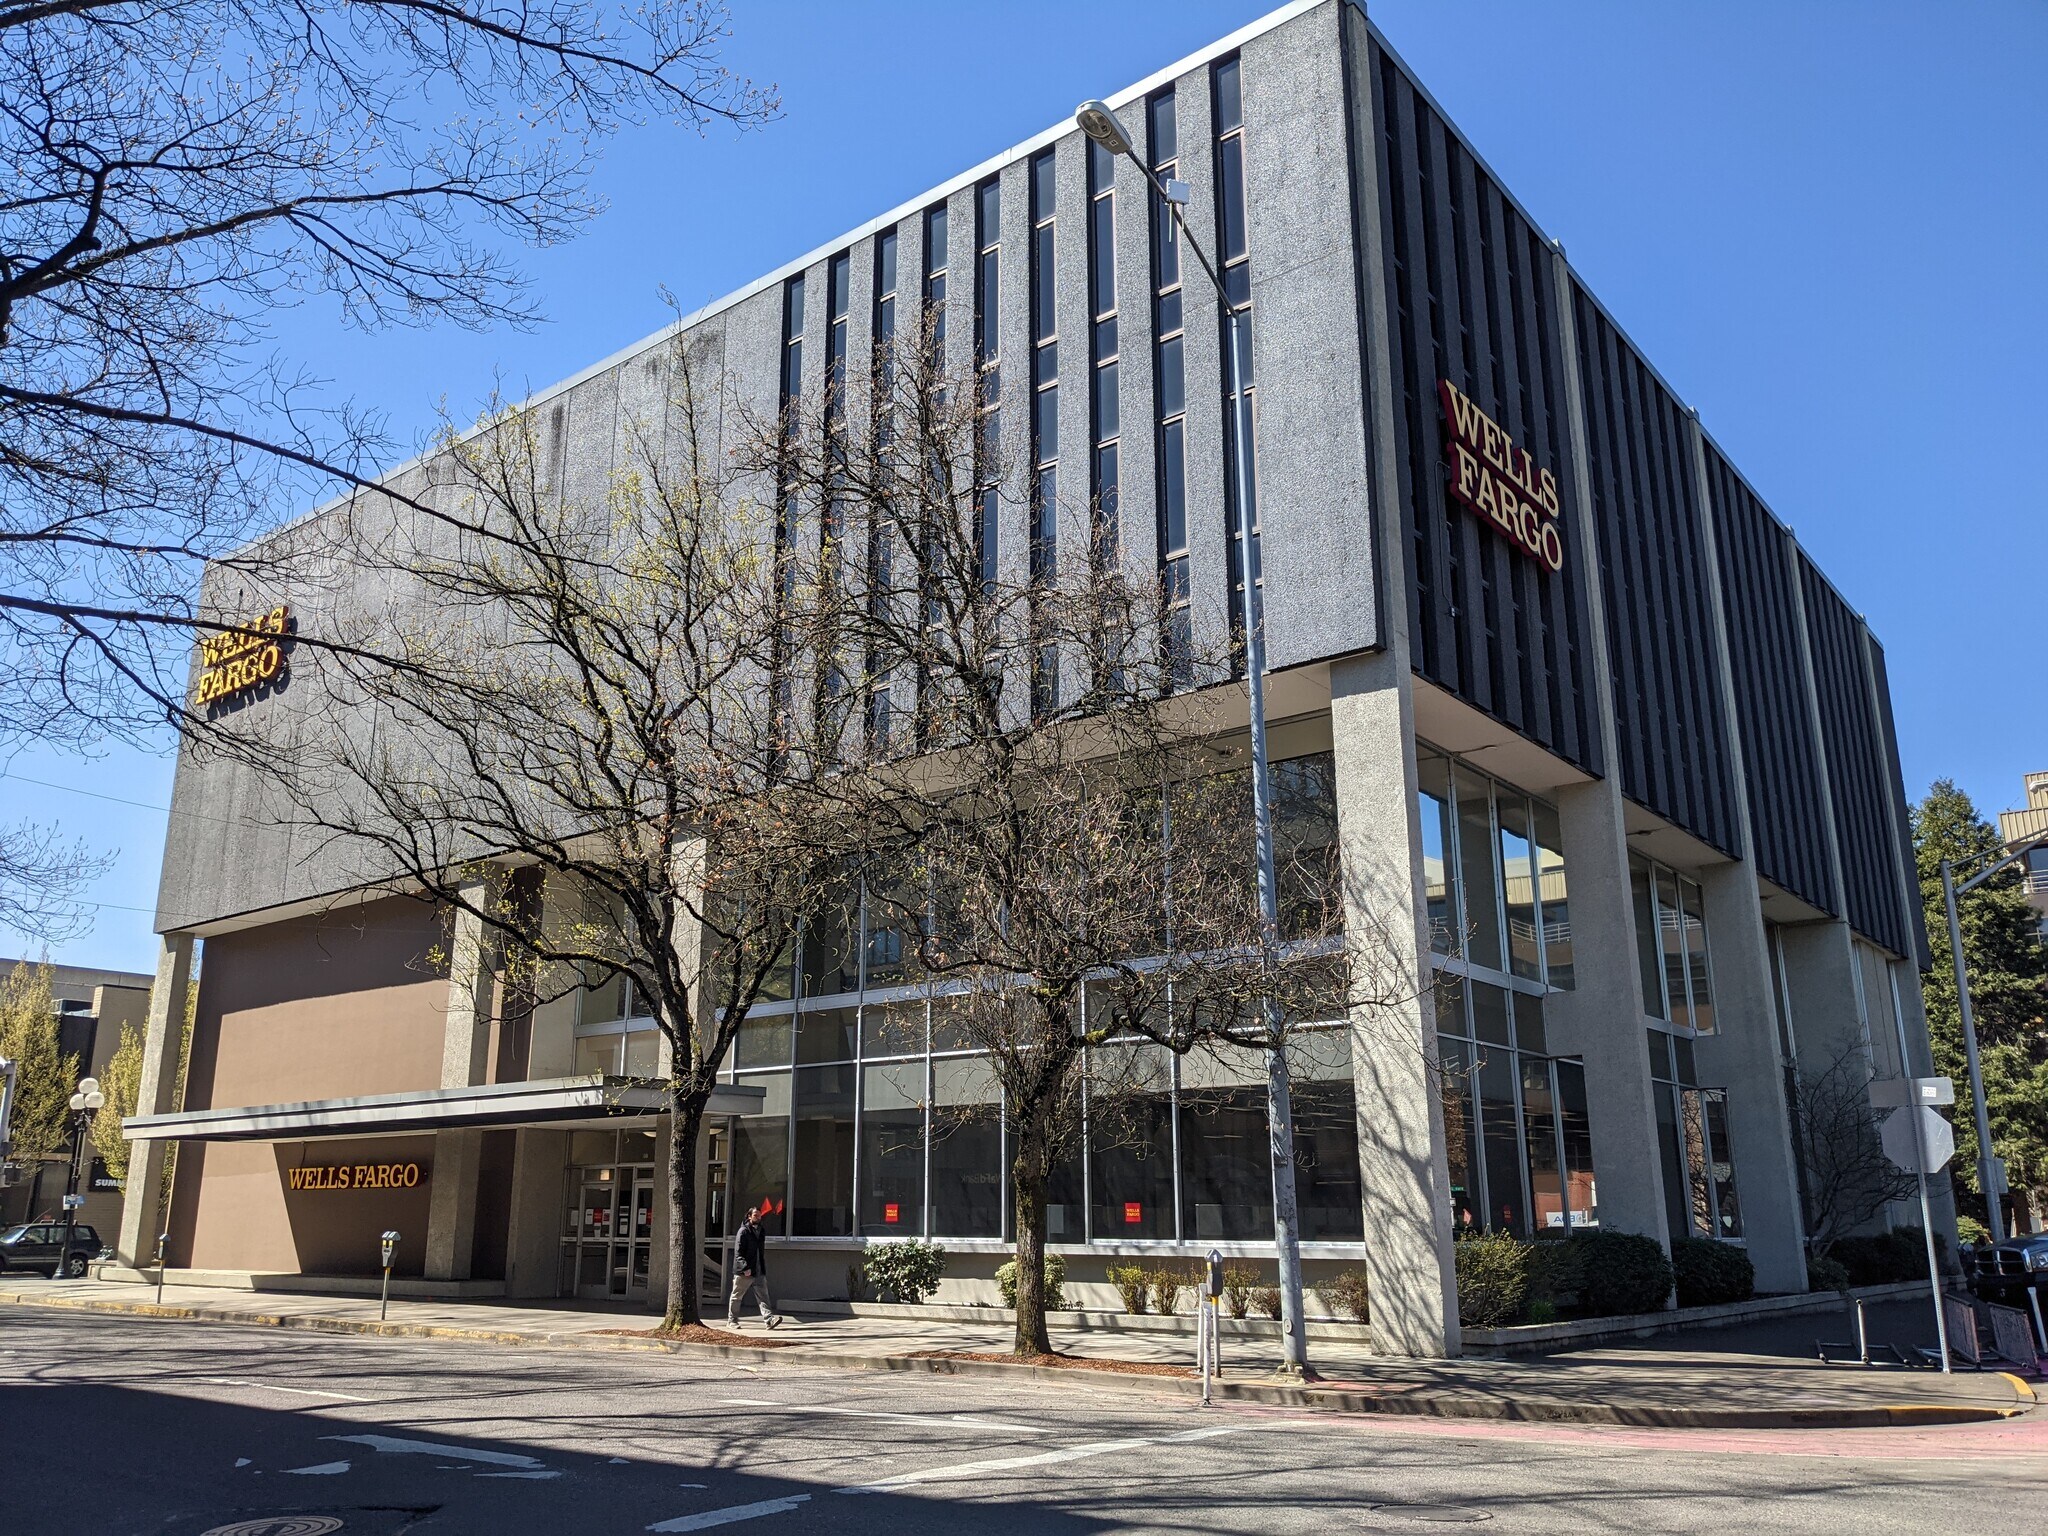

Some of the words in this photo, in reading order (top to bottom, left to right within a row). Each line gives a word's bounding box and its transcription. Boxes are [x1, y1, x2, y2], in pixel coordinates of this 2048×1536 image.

[1445, 379, 1559, 520] WELLS
[1455, 442, 1563, 572] FARGO
[195, 645, 278, 704] FARGO
[288, 1166, 350, 1190] WELLS
[352, 1163, 419, 1188] FARGO
